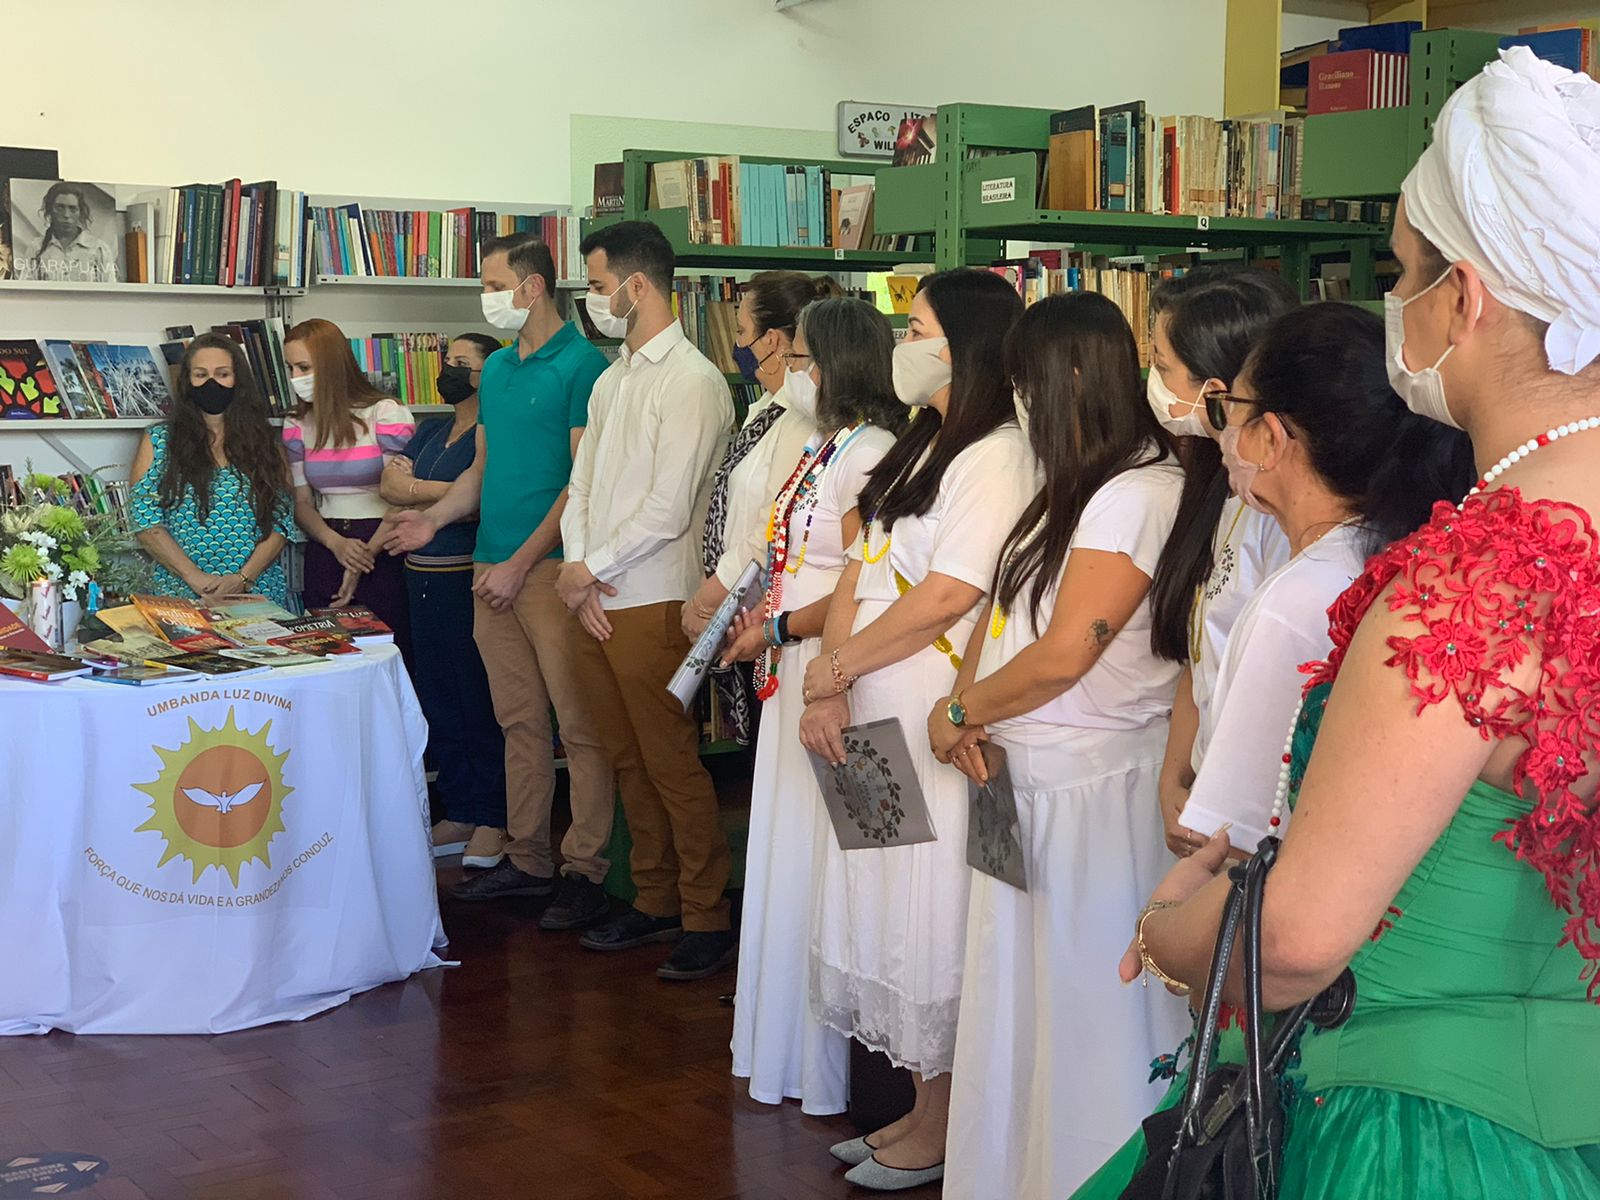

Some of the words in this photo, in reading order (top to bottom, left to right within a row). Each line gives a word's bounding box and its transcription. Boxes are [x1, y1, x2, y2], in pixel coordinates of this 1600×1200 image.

[847, 110, 890, 134] ESPAÇO
[982, 181, 1013, 191] LITERATURA
[982, 192, 1012, 202] BRASILEIRA
[1200, 217, 1207, 228] Q
[147, 690, 220, 717] UMBANDA
[223, 689, 251, 700] LUZ
[253, 691, 292, 711] DIVINA
[84, 847, 117, 881] FORÇA
[116, 875, 142, 895] QUE
[142, 887, 168, 903] NOS
[168, 891, 185, 904] DÁ
[187, 894, 215, 906] VIDA
[217, 896, 224, 907] E
[225, 897, 233, 907] A
[292, 832, 334, 869] CONDUZ
